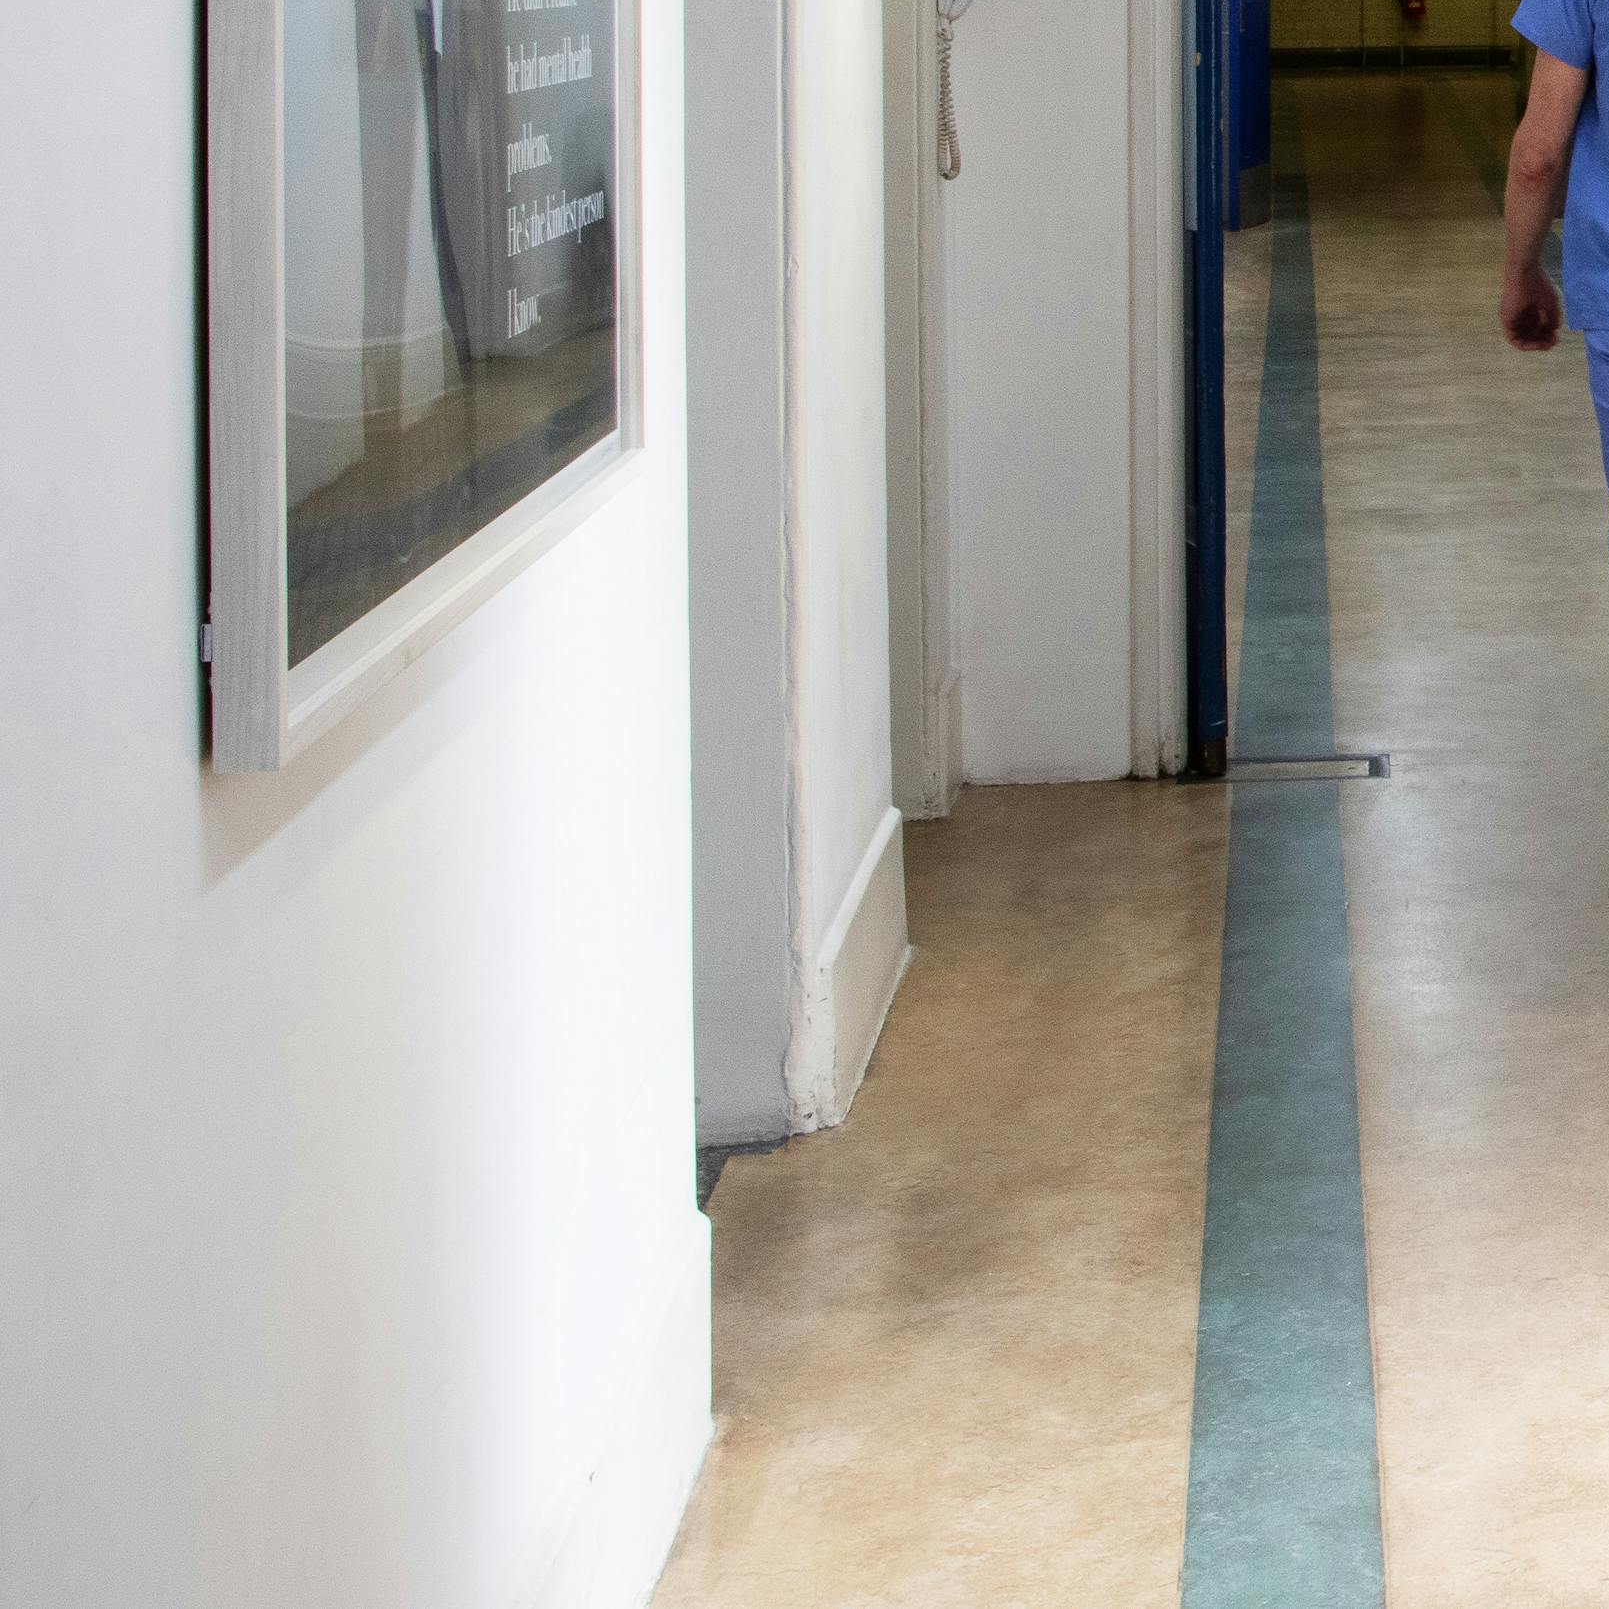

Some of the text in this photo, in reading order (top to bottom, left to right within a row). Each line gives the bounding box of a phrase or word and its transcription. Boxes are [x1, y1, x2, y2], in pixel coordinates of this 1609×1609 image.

[507, 34, 592, 94] he had mental health
[531, 201, 545, 248] the
[547, 190, 577, 241] kindest
[577, 190, 604, 243] person
